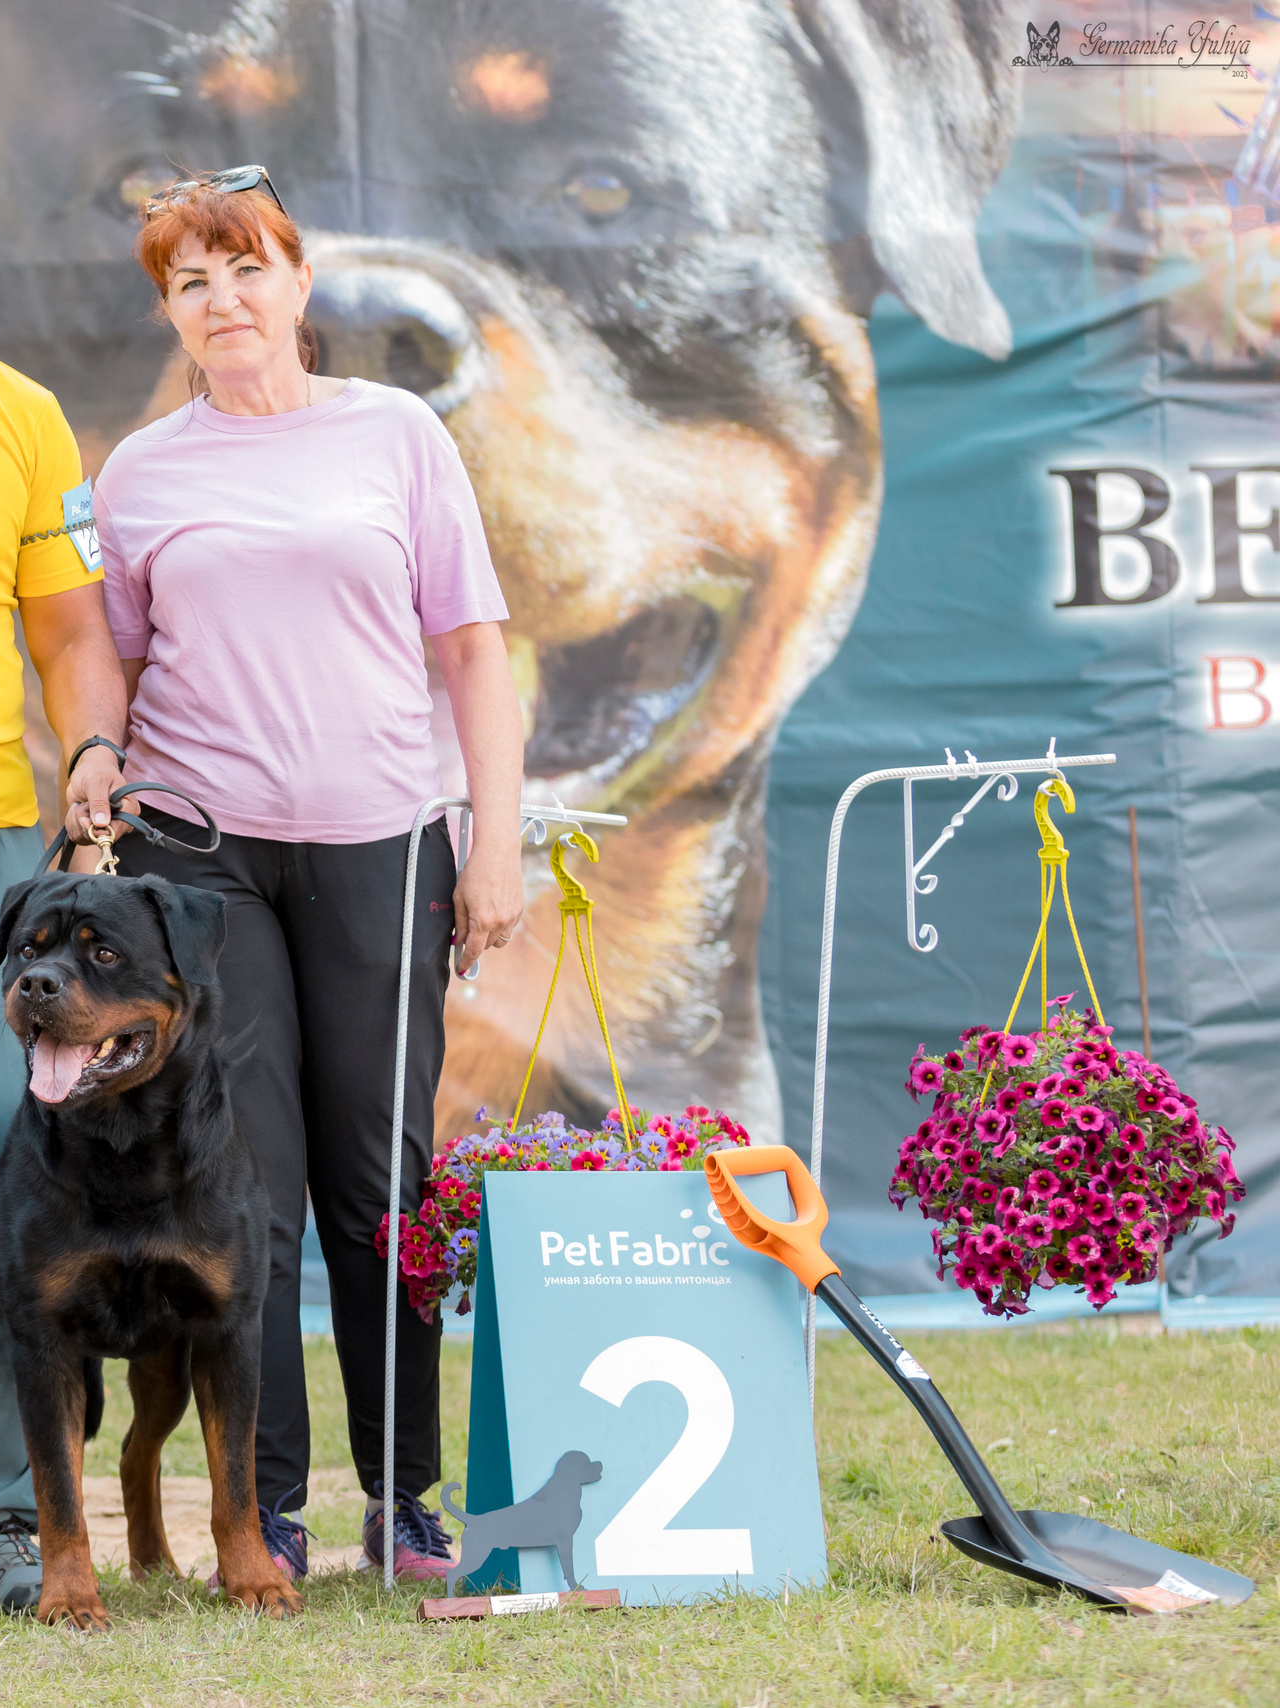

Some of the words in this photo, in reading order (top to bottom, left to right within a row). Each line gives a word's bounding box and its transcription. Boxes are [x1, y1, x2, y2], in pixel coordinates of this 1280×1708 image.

[540, 1231, 604, 1267] Pet
[609, 1225, 730, 1267] Fabric
[544, 1275, 580, 1287] умная
[582, 1273, 621, 1285] забота
[624, 1276, 633, 1285] о
[635, 1275, 672, 1285] ваших
[675, 1275, 732, 1287] питомцах
[579, 1335, 754, 1576] 2
